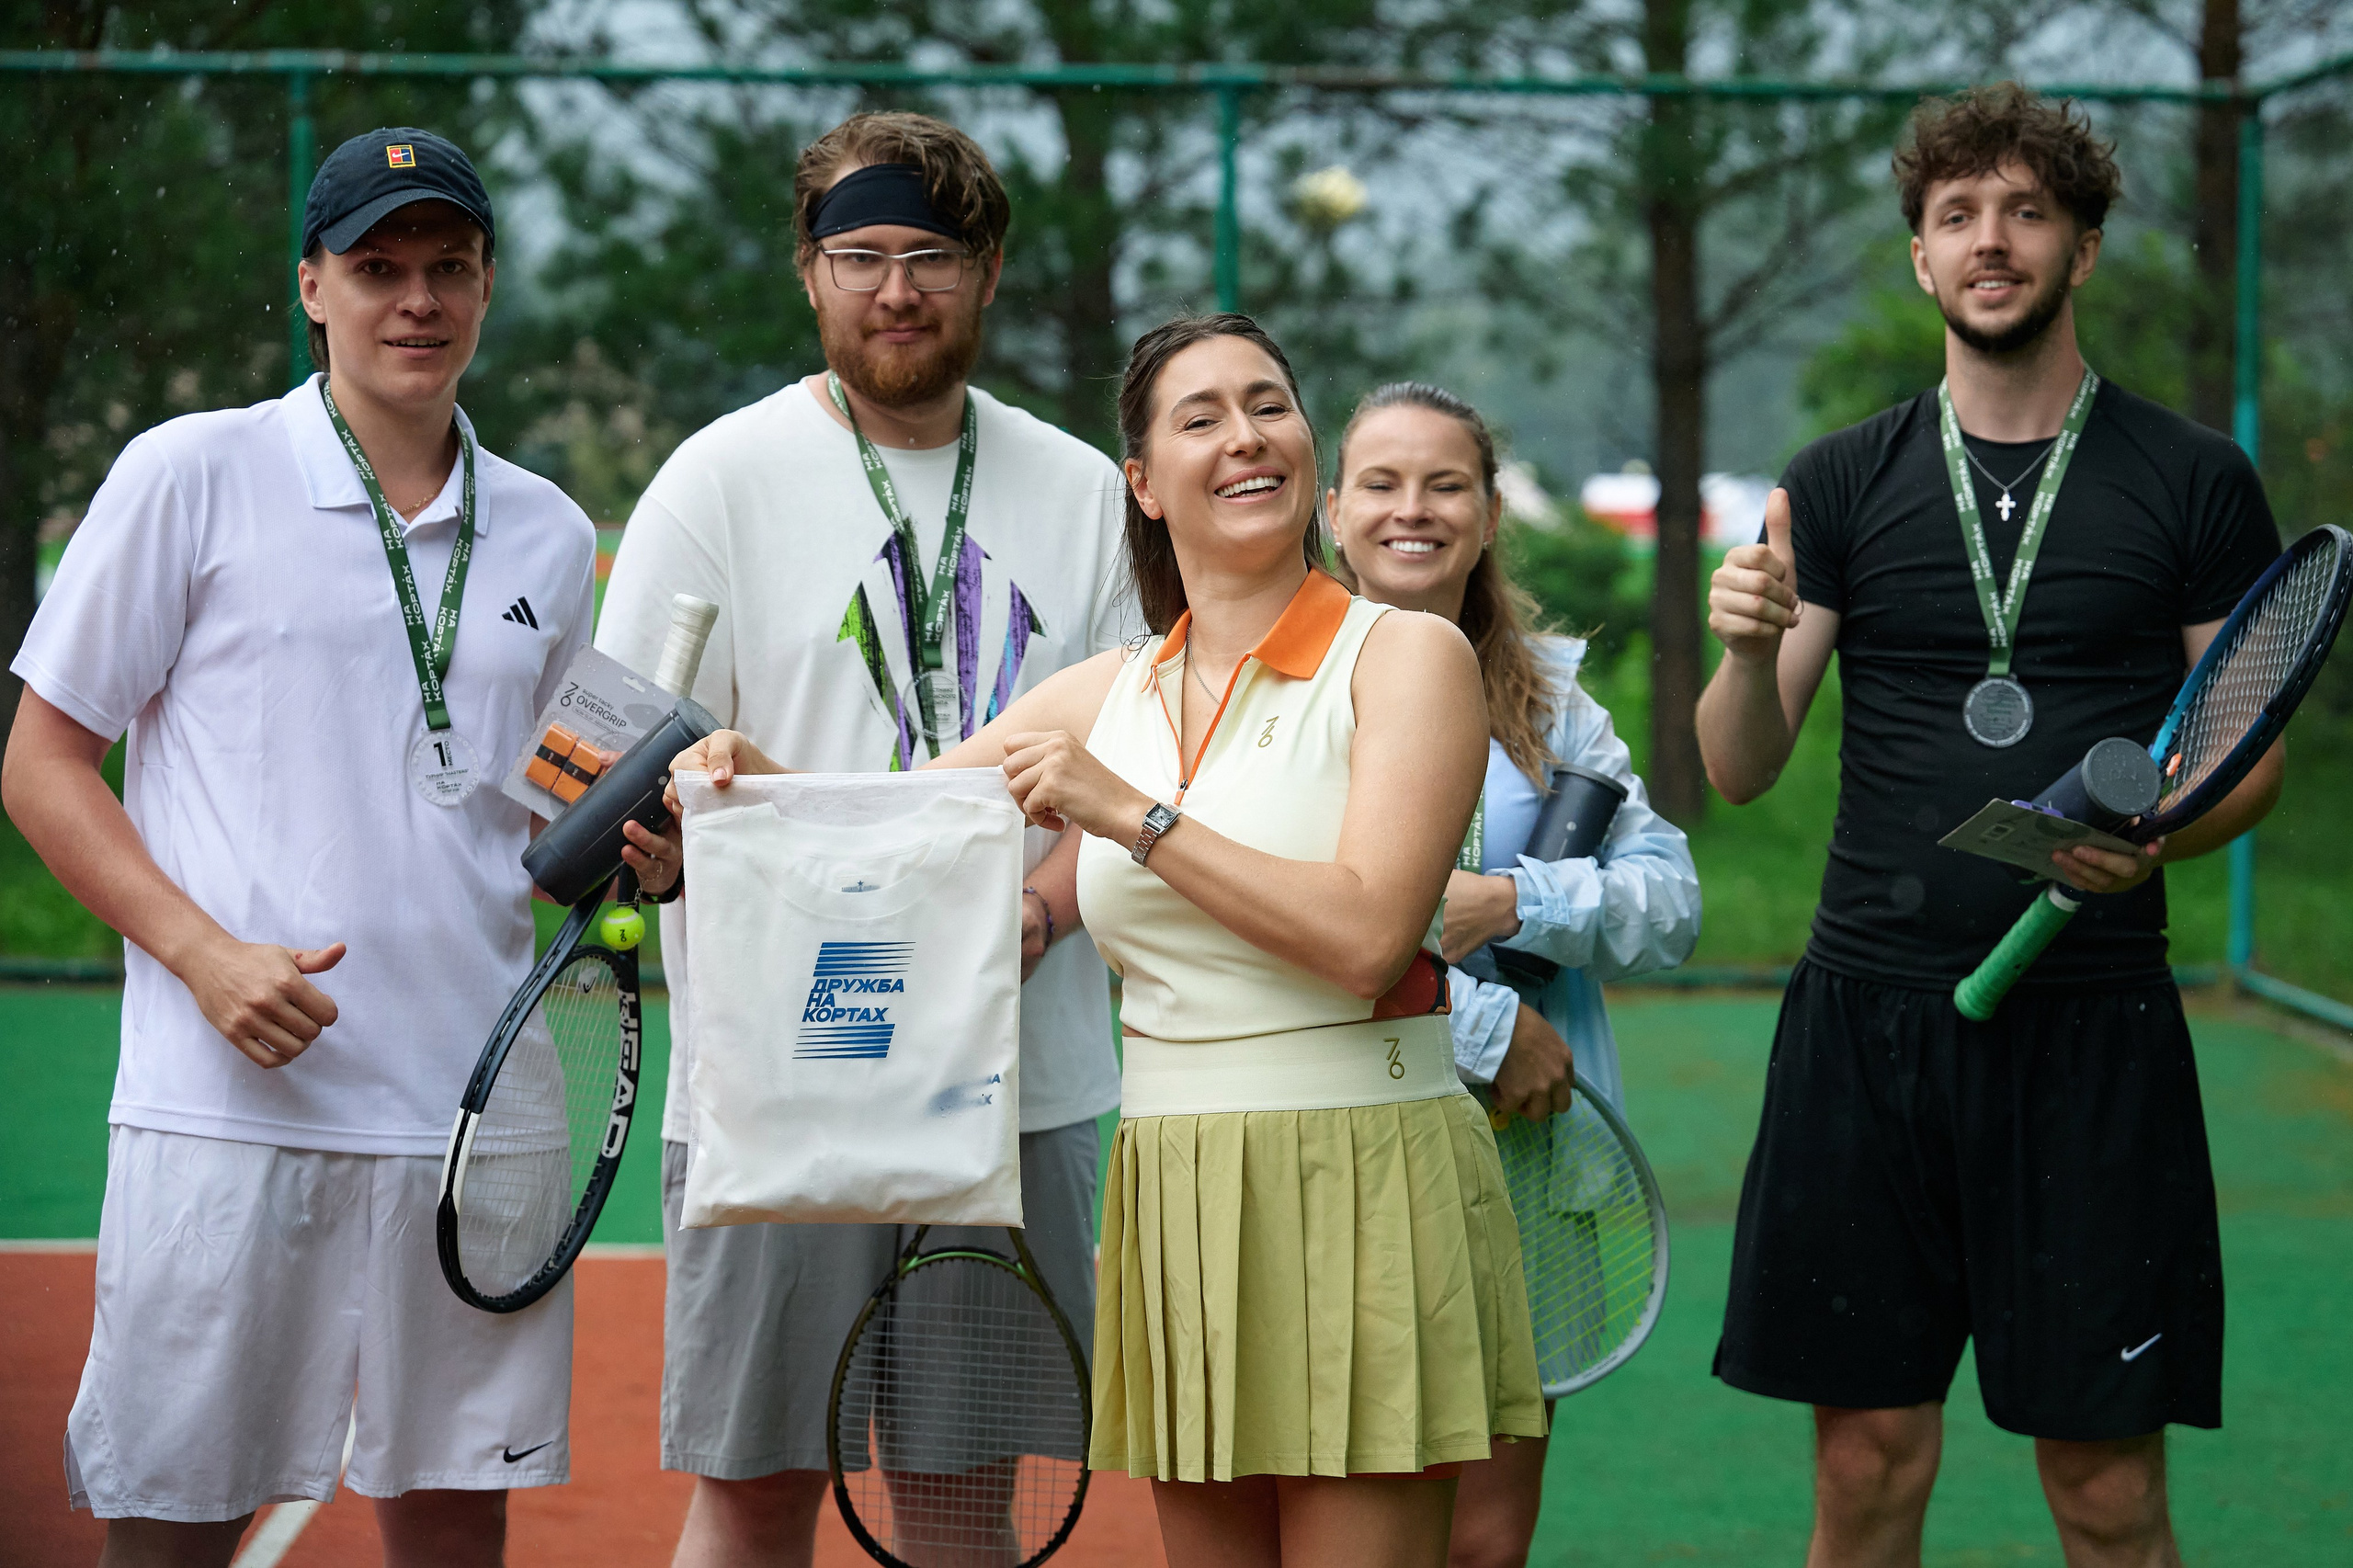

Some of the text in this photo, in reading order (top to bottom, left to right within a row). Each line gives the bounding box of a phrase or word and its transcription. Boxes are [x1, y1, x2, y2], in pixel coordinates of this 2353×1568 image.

[951, 494, 961, 512] НА
[384, 528, 395, 551] НА
[461, 542, 471, 562] НА
[938, 556, 948, 575] НА
[404, 604, 415, 626] НА
[448, 608, 458, 628] НА
[925, 621, 934, 642] НА
[422, 681, 432, 703] НА
[576, 695, 627, 728] OVERGRIP
[433, 741, 446, 767] 1
[1462, 846, 1472, 868] НА
[811, 978, 905, 994] ДРУЖБА
[806, 993, 835, 1007] НА
[801, 1007, 890, 1023] КОРТАХ
[601, 988, 639, 1159] HEAD
